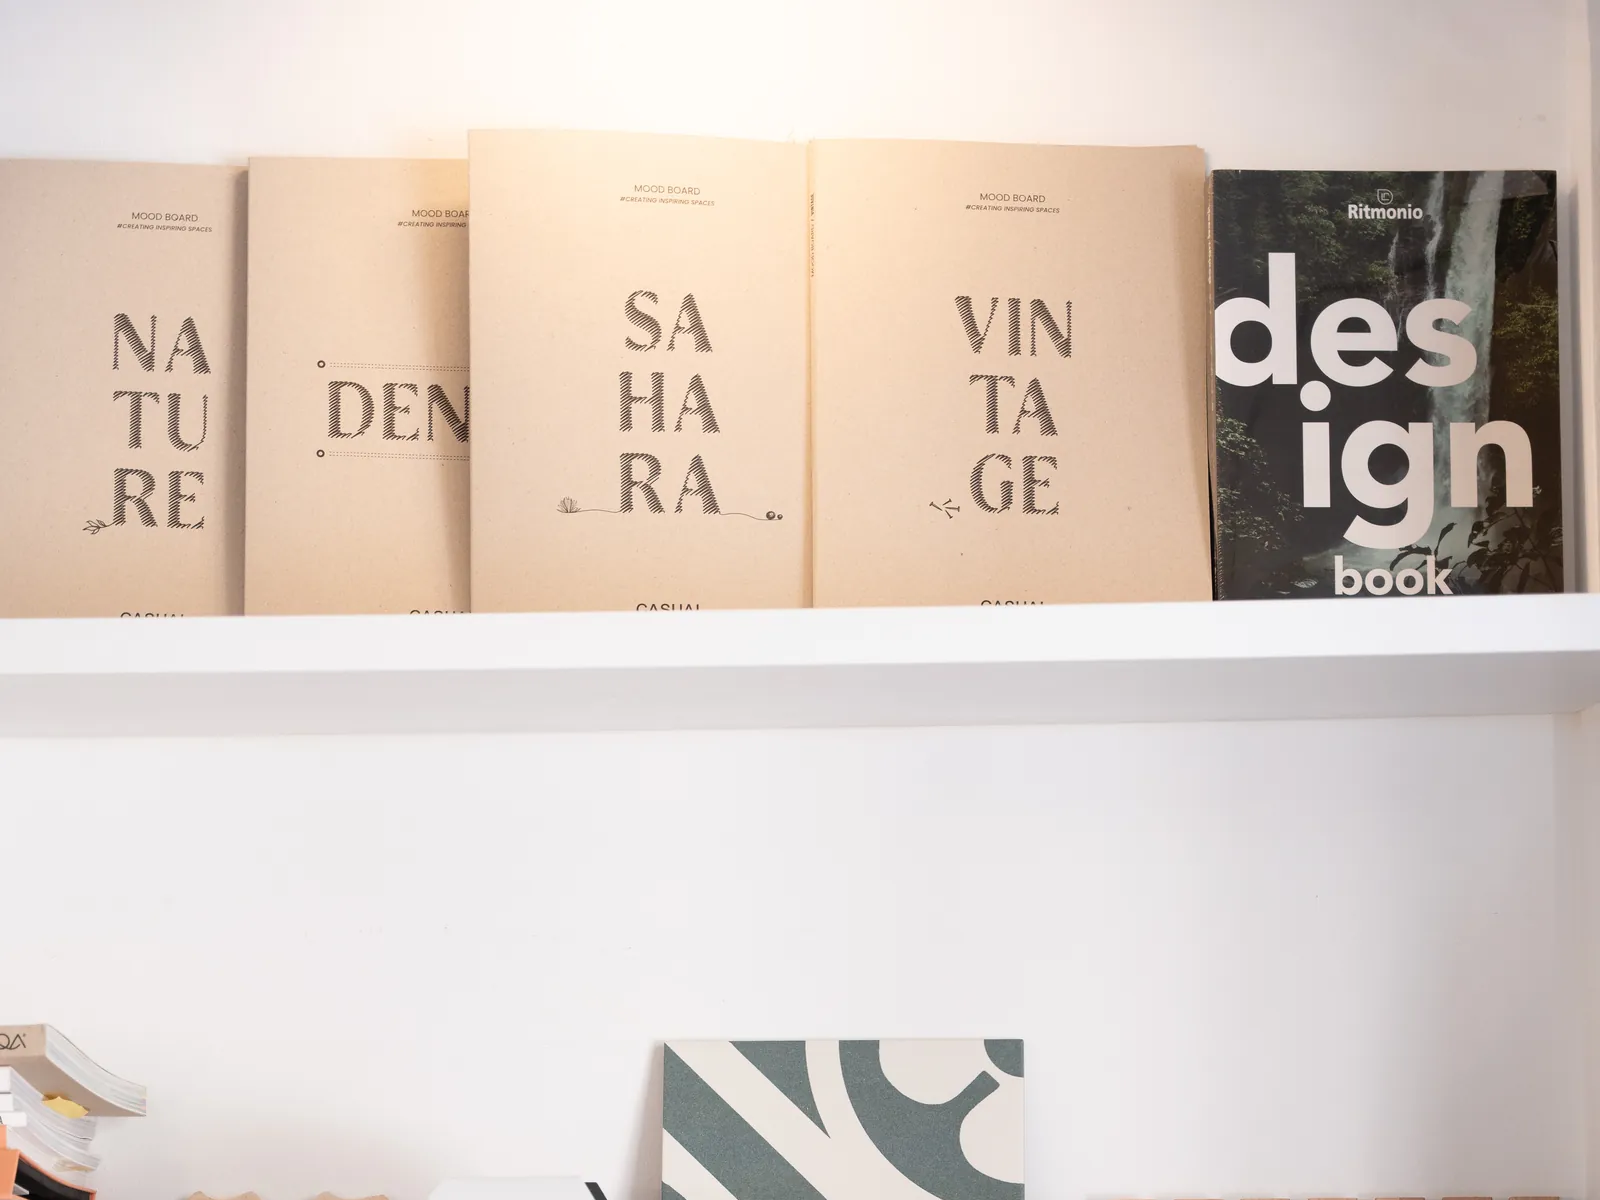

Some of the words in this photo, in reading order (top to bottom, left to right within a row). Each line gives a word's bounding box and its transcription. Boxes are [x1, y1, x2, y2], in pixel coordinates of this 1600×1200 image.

[131, 212, 163, 221] MOOD
[165, 213, 199, 222] BOARD
[411, 209, 443, 218] MOOD
[619, 196, 658, 204] #CREATING
[634, 184, 665, 194] MOOD
[667, 185, 701, 195] BOARD
[979, 193, 1010, 202] MOOD
[1012, 194, 1046, 203] BOARD
[1003, 205, 1035, 213] INSPIRING
[1035, 206, 1060, 214] SPACES
[1347, 203, 1424, 220] Ritmonio
[116, 223, 155, 231] #CREATING
[155, 224, 187, 232] INSPIRING
[397, 220, 435, 228] #CREATING
[112, 312, 212, 375] NA
[623, 289, 713, 353] SA
[954, 294, 1073, 359] VIN
[1214, 252, 1478, 388] des
[112, 389, 209, 453] TU
[327, 380, 470, 443] DEN
[618, 370, 721, 434] HA
[968, 374, 1059, 437] TA
[618, 452, 721, 515] RA
[969, 453, 1060, 516] GE
[1299, 380, 1534, 550] ign
[112, 467, 205, 530] RE
[1334, 555, 1454, 596] book
